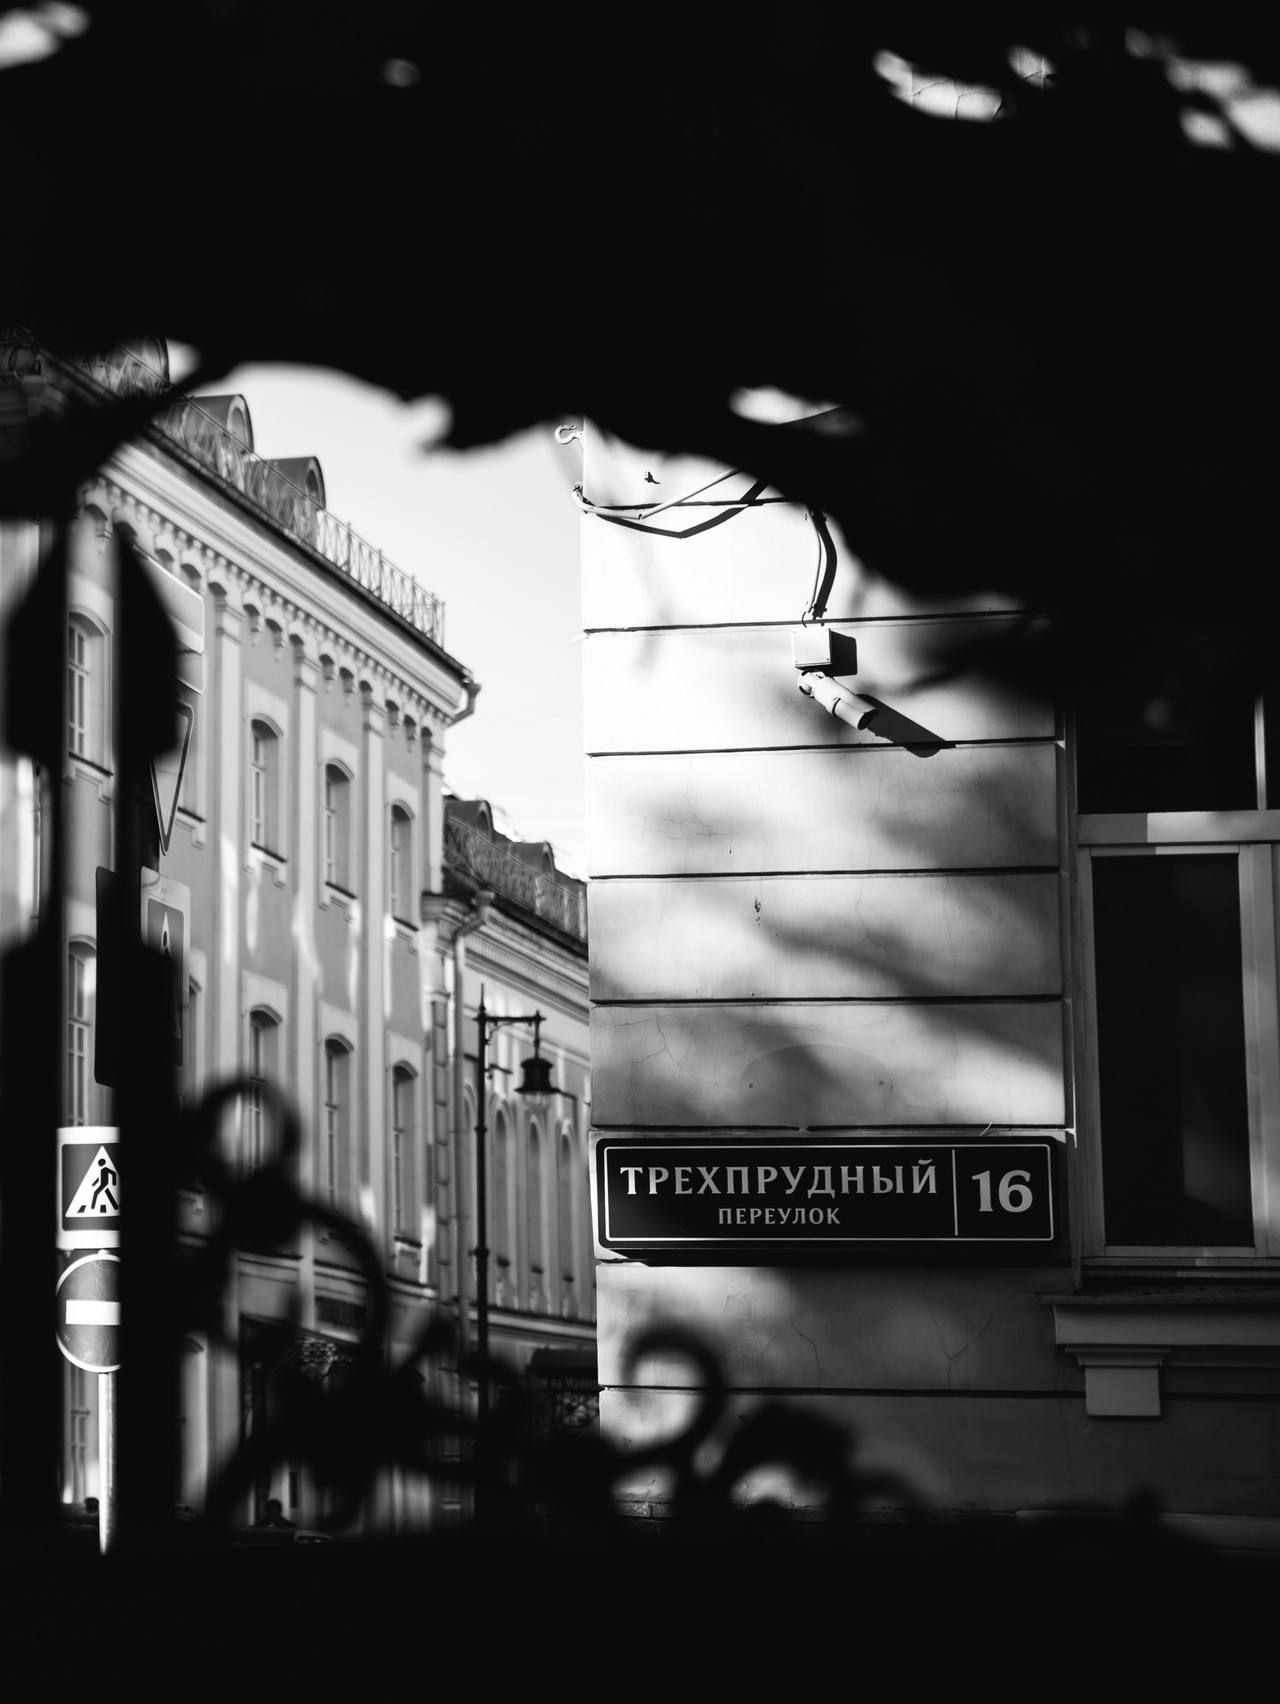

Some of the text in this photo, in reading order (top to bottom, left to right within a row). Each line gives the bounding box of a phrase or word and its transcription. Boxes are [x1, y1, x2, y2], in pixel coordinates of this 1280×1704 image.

[620, 1158, 938, 1199] ТРЕХПРУДНЫЙ
[971, 1169, 1034, 1213] 16
[718, 1207, 841, 1225] ПЕРЕУЛОК
